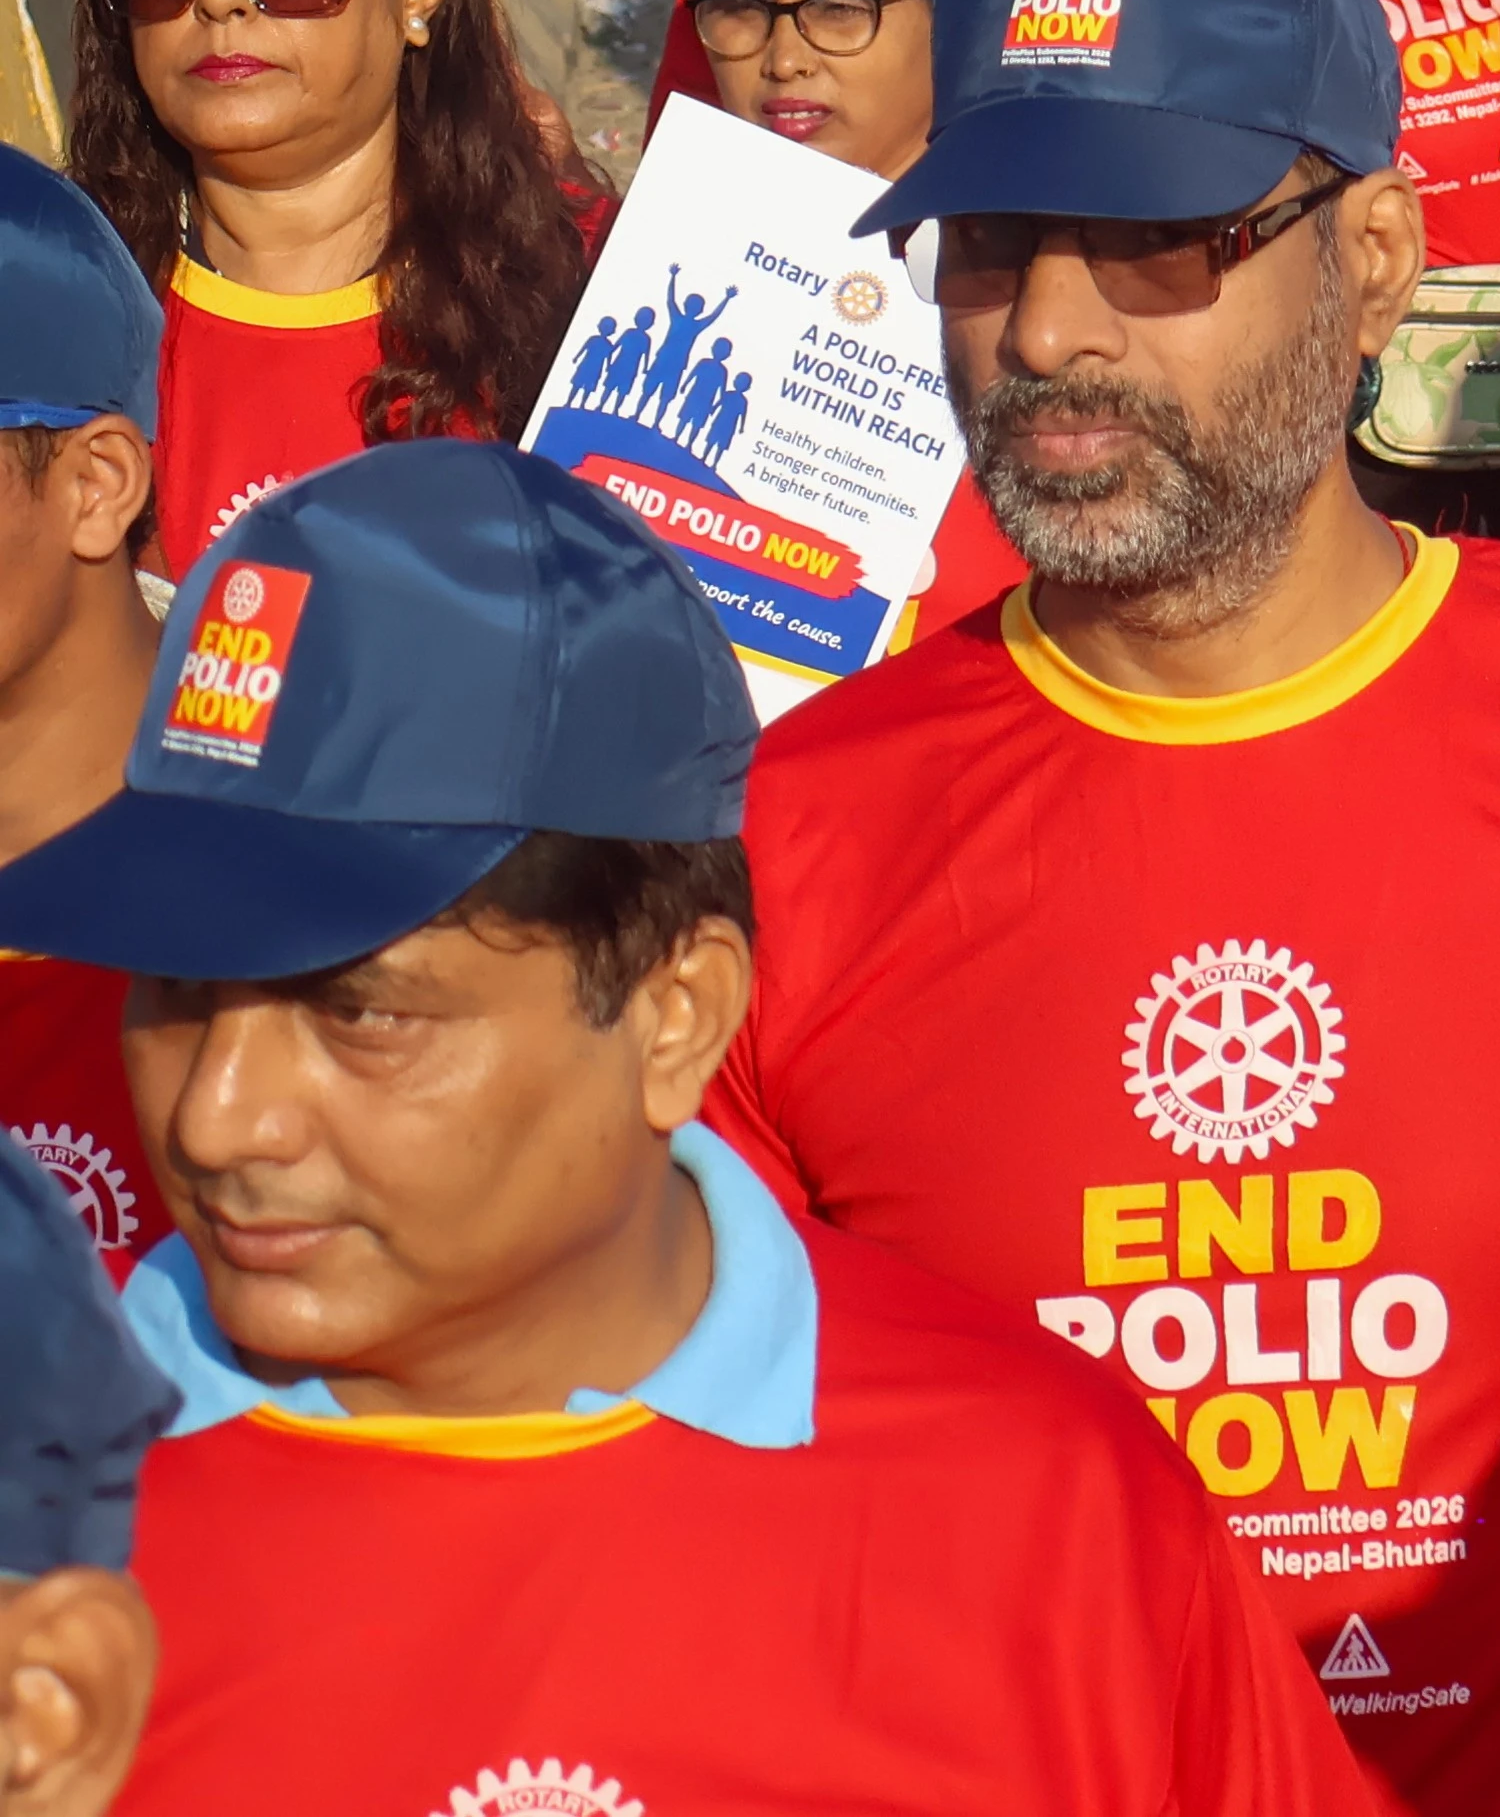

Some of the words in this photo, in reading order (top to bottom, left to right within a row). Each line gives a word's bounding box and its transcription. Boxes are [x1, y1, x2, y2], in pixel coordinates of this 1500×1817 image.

[1016, 12, 1108, 43] NOW
[743, 241, 829, 297] Rotary
[792, 350, 879, 400] WORLD
[886, 384, 907, 411] IS
[800, 324, 819, 346] A
[825, 331, 948, 399] POLIO-FRE
[779, 377, 868, 429] WITHIN
[868, 413, 947, 461] REACH
[752, 440, 824, 479] Stronger
[820, 466, 918, 520] communities.
[761, 418, 823, 456] Healthy
[823, 442, 887, 483] children.
[743, 462, 756, 477] A
[758, 467, 820, 505] brighter
[822, 490, 871, 526] future.
[604, 473, 667, 518] END
[668, 498, 762, 553] POLIO
[762, 533, 840, 581] NOW
[196, 622, 273, 666] END
[751, 598, 785, 625] the
[786, 616, 844, 650] cause.
[178, 653, 281, 699] POLIO
[174, 687, 258, 733] NOW
[1192, 963, 1277, 991] ROTARY
[1156, 1071, 1317, 1141] INTERNATIONAL
[1083, 1169, 1382, 1287] END
[1036, 1273, 1449, 1390] POLIO
[1228, 1508, 1388, 1538] committee
[1396, 1496, 1465, 1528] 2026
[1261, 1539, 1467, 1579] Nepal-Bhutan
